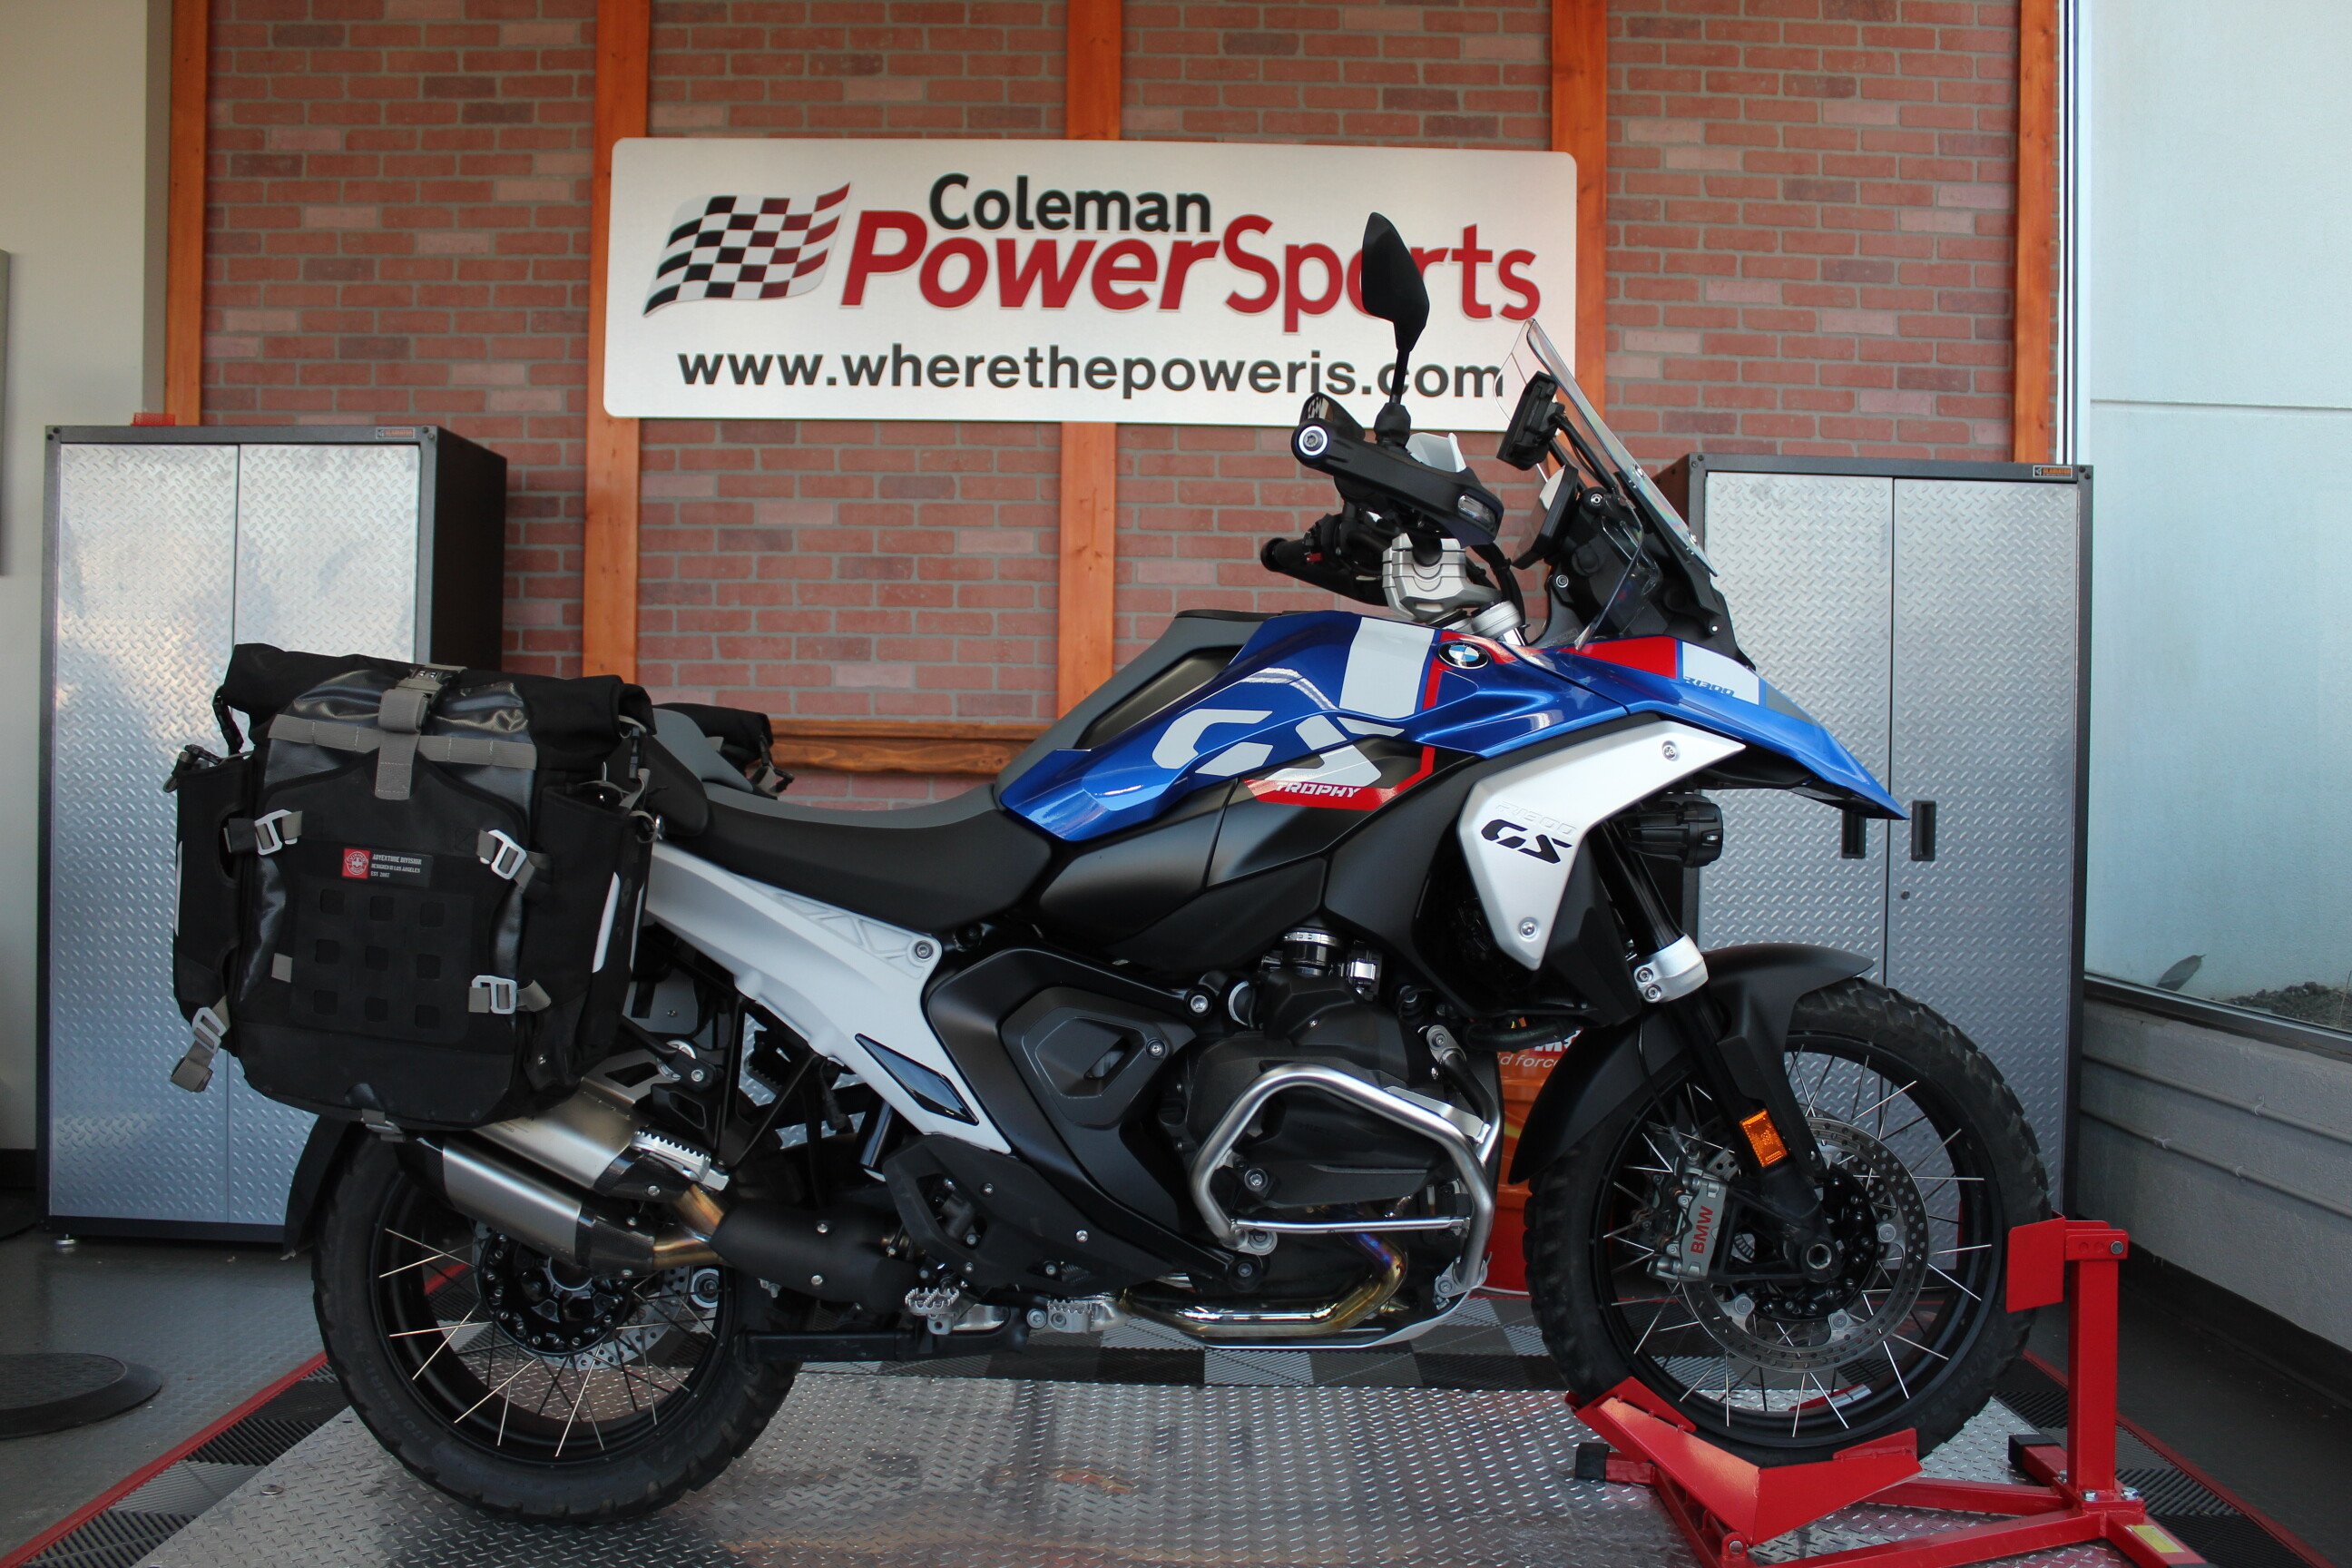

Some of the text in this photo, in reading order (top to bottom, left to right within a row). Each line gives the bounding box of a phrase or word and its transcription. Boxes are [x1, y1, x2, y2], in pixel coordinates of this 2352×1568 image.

[929, 172, 1210, 233] Coleman
[678, 344, 1504, 399] www.wherethepoweris.com
[1274, 781, 1362, 798] TROPHY
[400, 857, 423, 866] DIVISION
[1480, 818, 1573, 865] GS
[1514, 1054, 1559, 1069] forc
[1690, 1204, 1714, 1254] BMW
